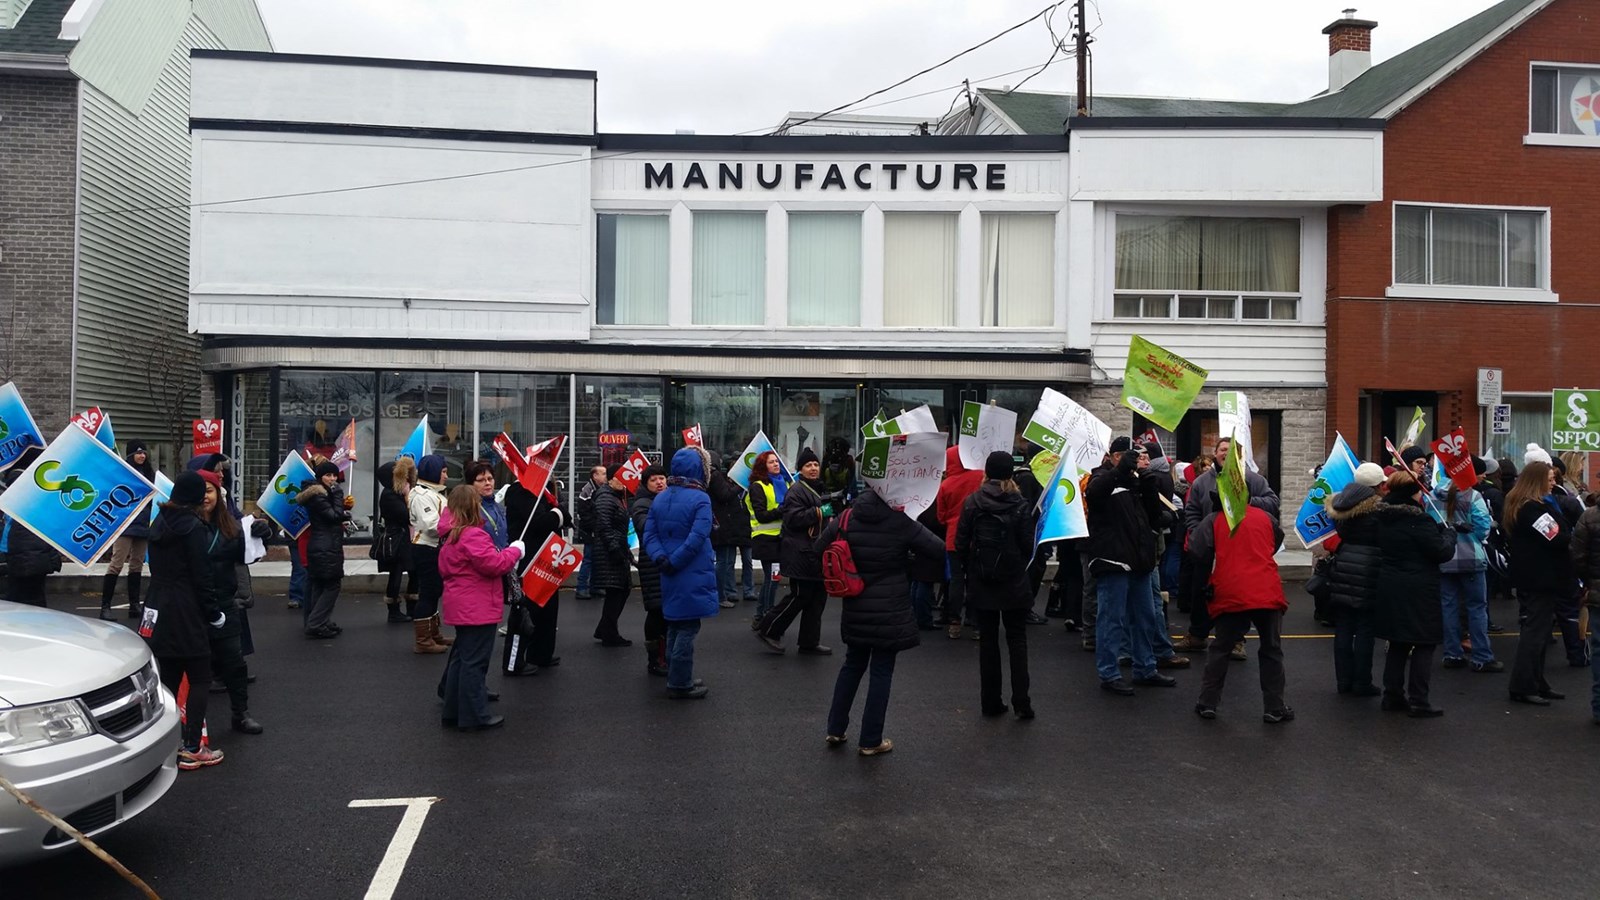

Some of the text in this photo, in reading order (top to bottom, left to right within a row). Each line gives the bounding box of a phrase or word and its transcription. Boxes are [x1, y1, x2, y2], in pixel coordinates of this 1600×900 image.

[645, 162, 1006, 190] MANUFACTURE
[279, 402, 410, 418] ENTREPOSAGE
[0, 433, 34, 462] FPQ
[599, 434, 630, 445] OUVERT
[1553, 430, 1600, 449] SFPQ
[886, 465, 941, 480] TRAITANCE
[71, 484, 142, 551] SFPQ
[289, 505, 310, 528] SF
[1304, 509, 1330, 535] SF
[531, 565, 563, 587] L'AUSTÉRITÉ
